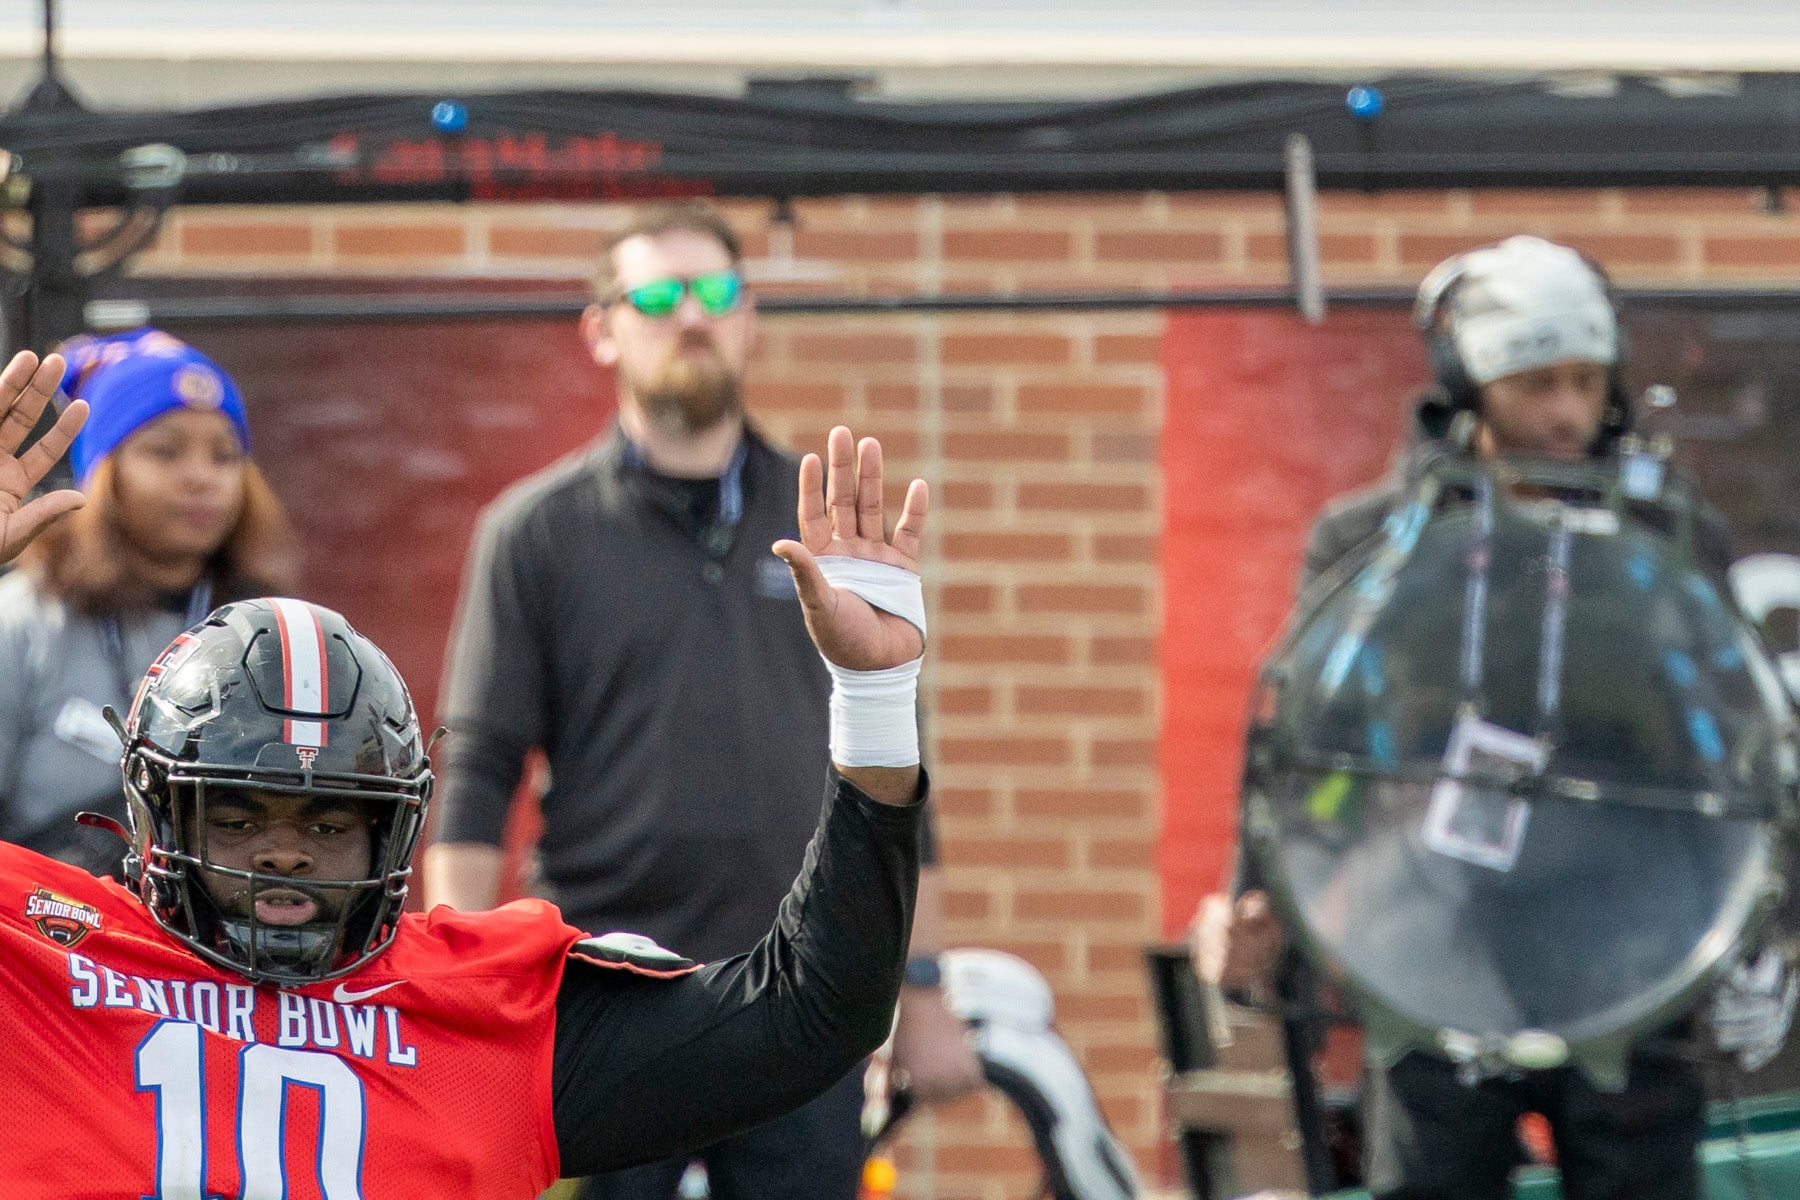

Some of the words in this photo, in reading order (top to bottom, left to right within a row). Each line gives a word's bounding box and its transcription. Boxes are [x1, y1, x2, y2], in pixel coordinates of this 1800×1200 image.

[26, 895, 71, 918] SENIOR
[71, 906, 101, 929] BOWL
[68, 952, 258, 1043] SENIOR
[277, 989, 418, 1067] BOWL
